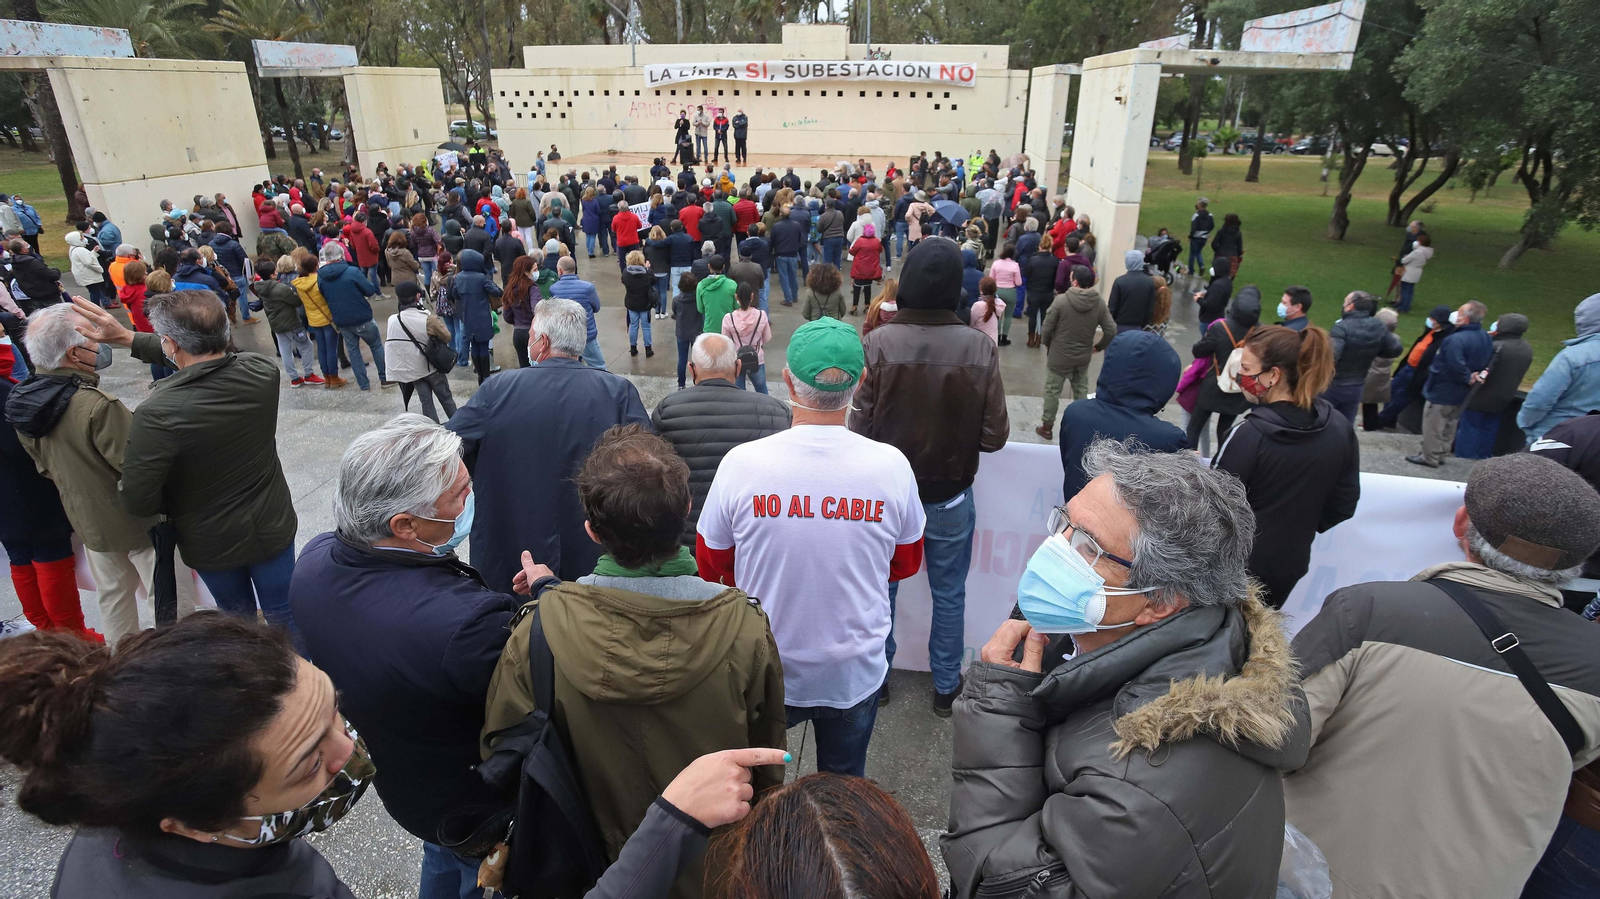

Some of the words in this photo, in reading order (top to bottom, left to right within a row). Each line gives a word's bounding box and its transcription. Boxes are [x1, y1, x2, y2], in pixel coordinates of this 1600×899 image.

[650, 68, 672, 83] LA
[784, 63, 931, 79] SUBESTACIÓN
[939, 64, 975, 83] NO
[753, 494, 781, 518] NO
[788, 495, 815, 518] AL
[821, 496, 885, 523] CABLE
